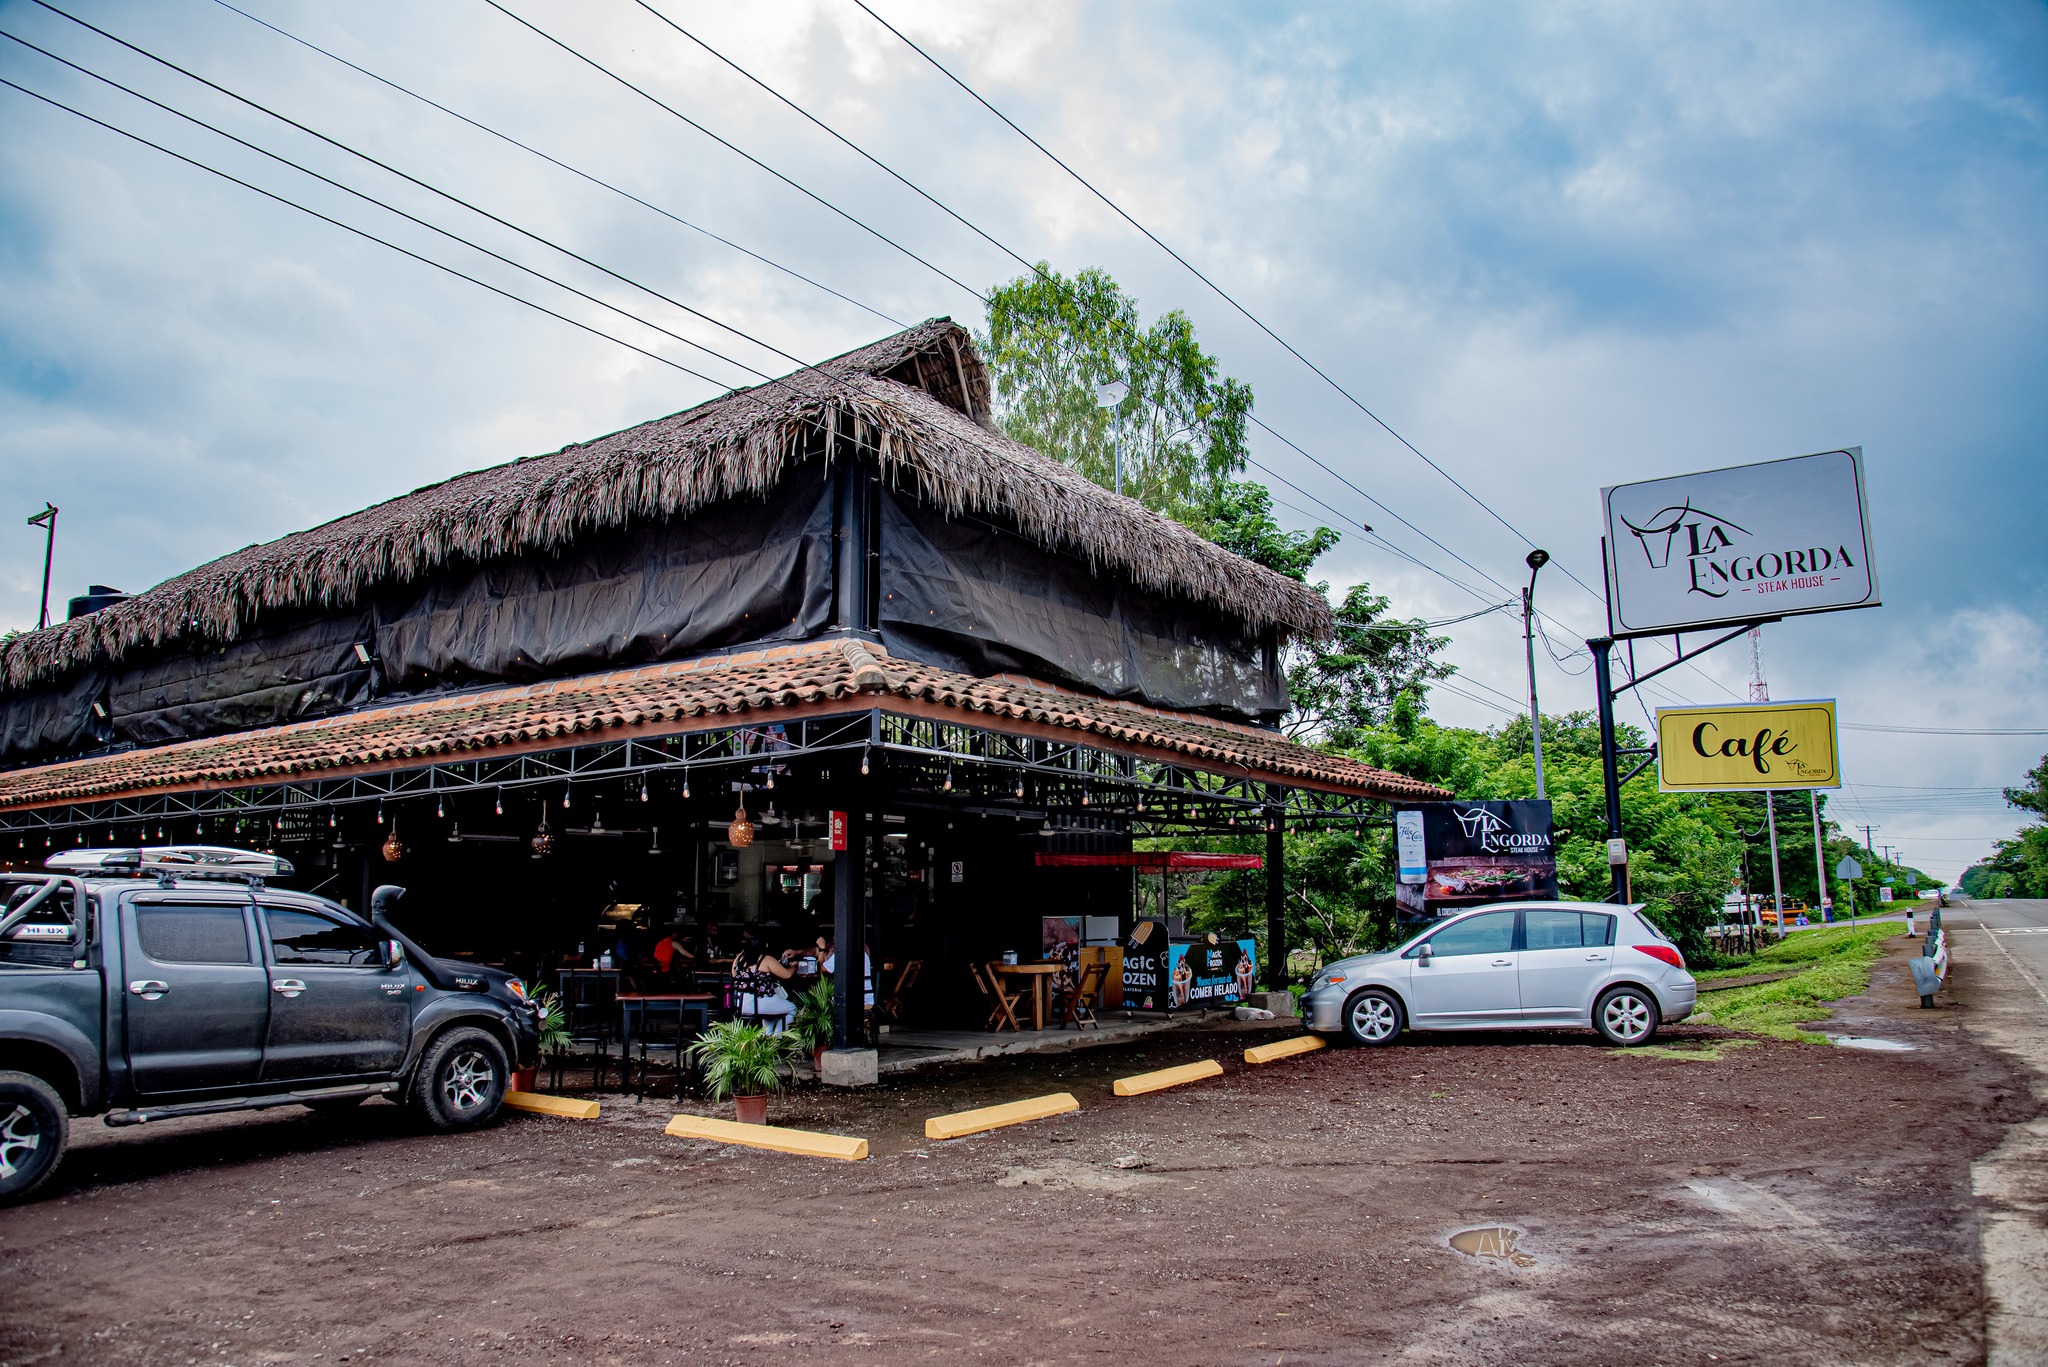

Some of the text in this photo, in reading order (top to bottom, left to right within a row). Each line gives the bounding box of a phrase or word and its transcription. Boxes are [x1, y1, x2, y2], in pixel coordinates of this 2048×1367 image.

[1683, 522, 1734, 557] LA
[1687, 544, 1855, 599] ENGORDA
[1757, 575, 1825, 594] STEAK HOUSE
[1692, 721, 1798, 774] Café
[1797, 767, 1827, 777] ENGORDA
[1481, 815, 1502, 831] LA
[1481, 832, 1551, 853] ENGORDA
[1123, 955, 1155, 970] AGIC
[455, 977, 478, 985] HILUX
[1123, 972, 1157, 986] OZEN
[1190, 982, 1238, 999] COMER HELADO
